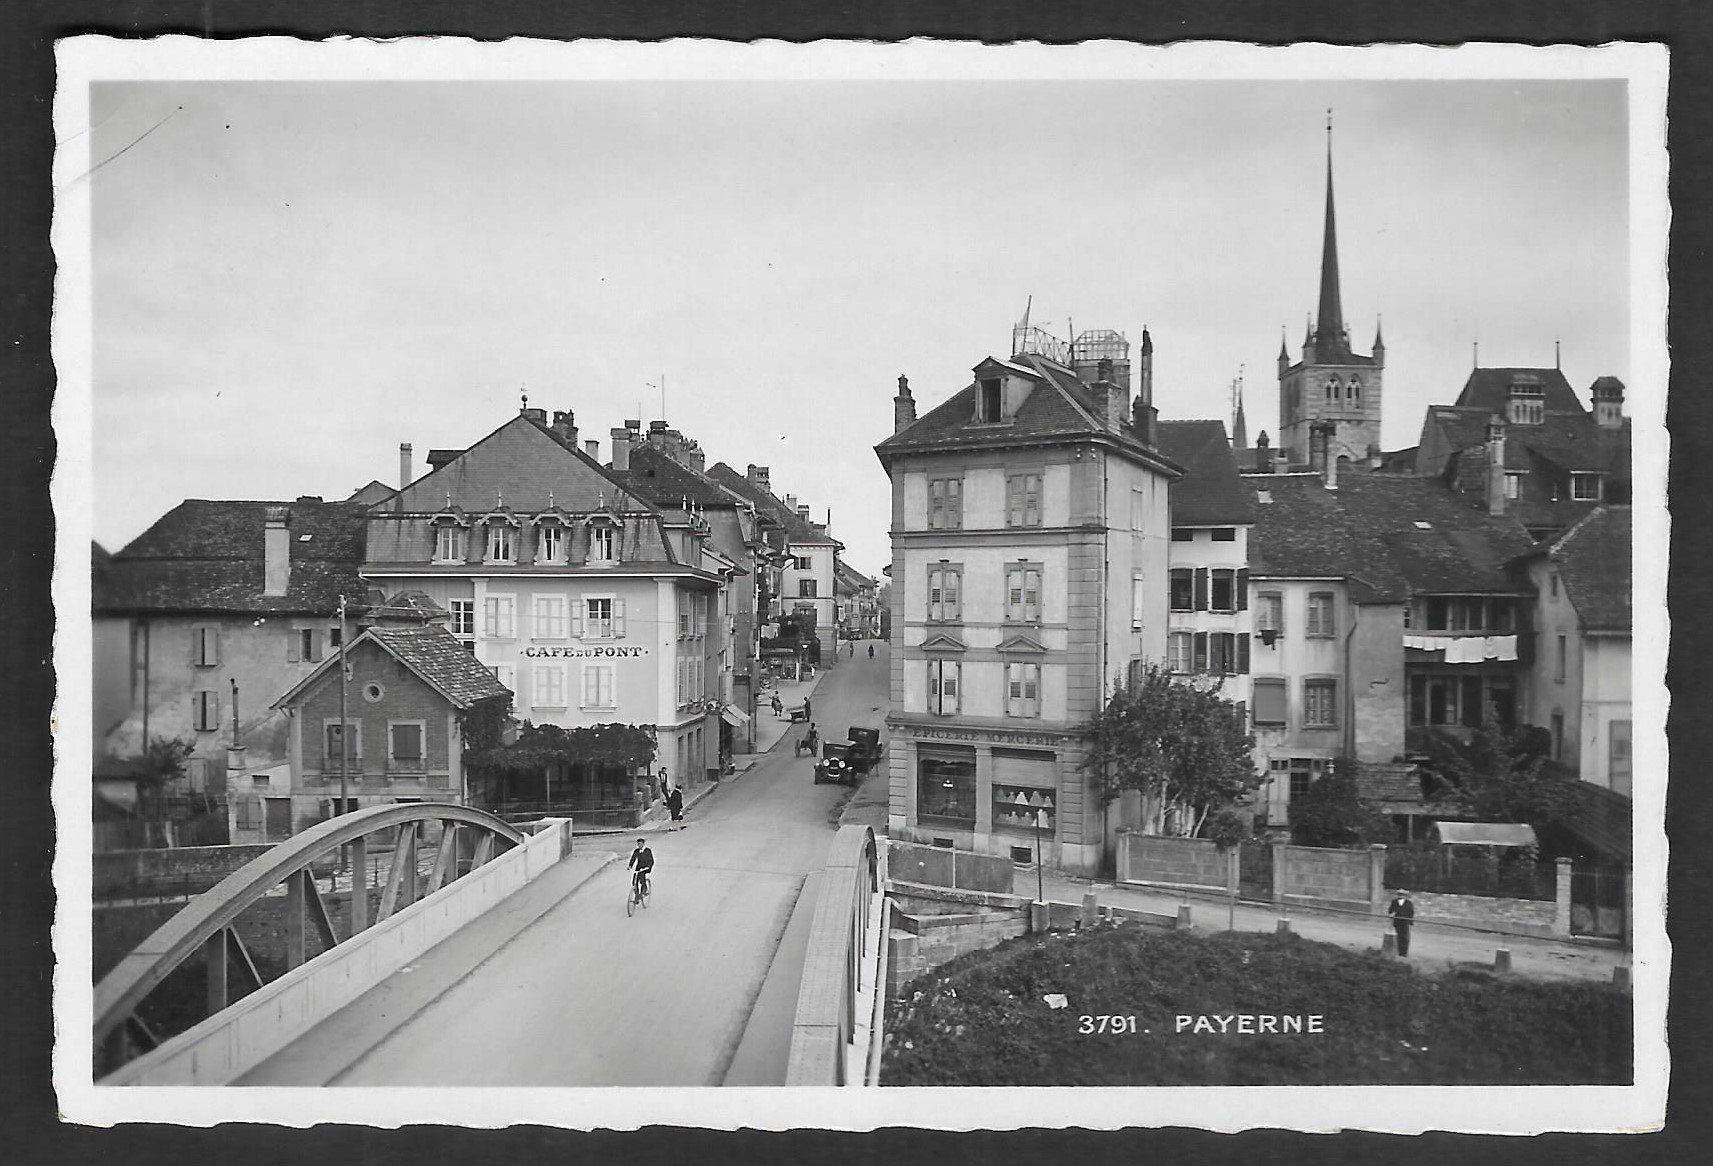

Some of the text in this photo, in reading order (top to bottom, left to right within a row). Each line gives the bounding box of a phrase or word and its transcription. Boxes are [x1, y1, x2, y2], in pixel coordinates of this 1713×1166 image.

[525, 646, 574, 658] CAFE
[593, 646, 642, 658] PONT
[912, 728, 980, 742] EPICERIE
